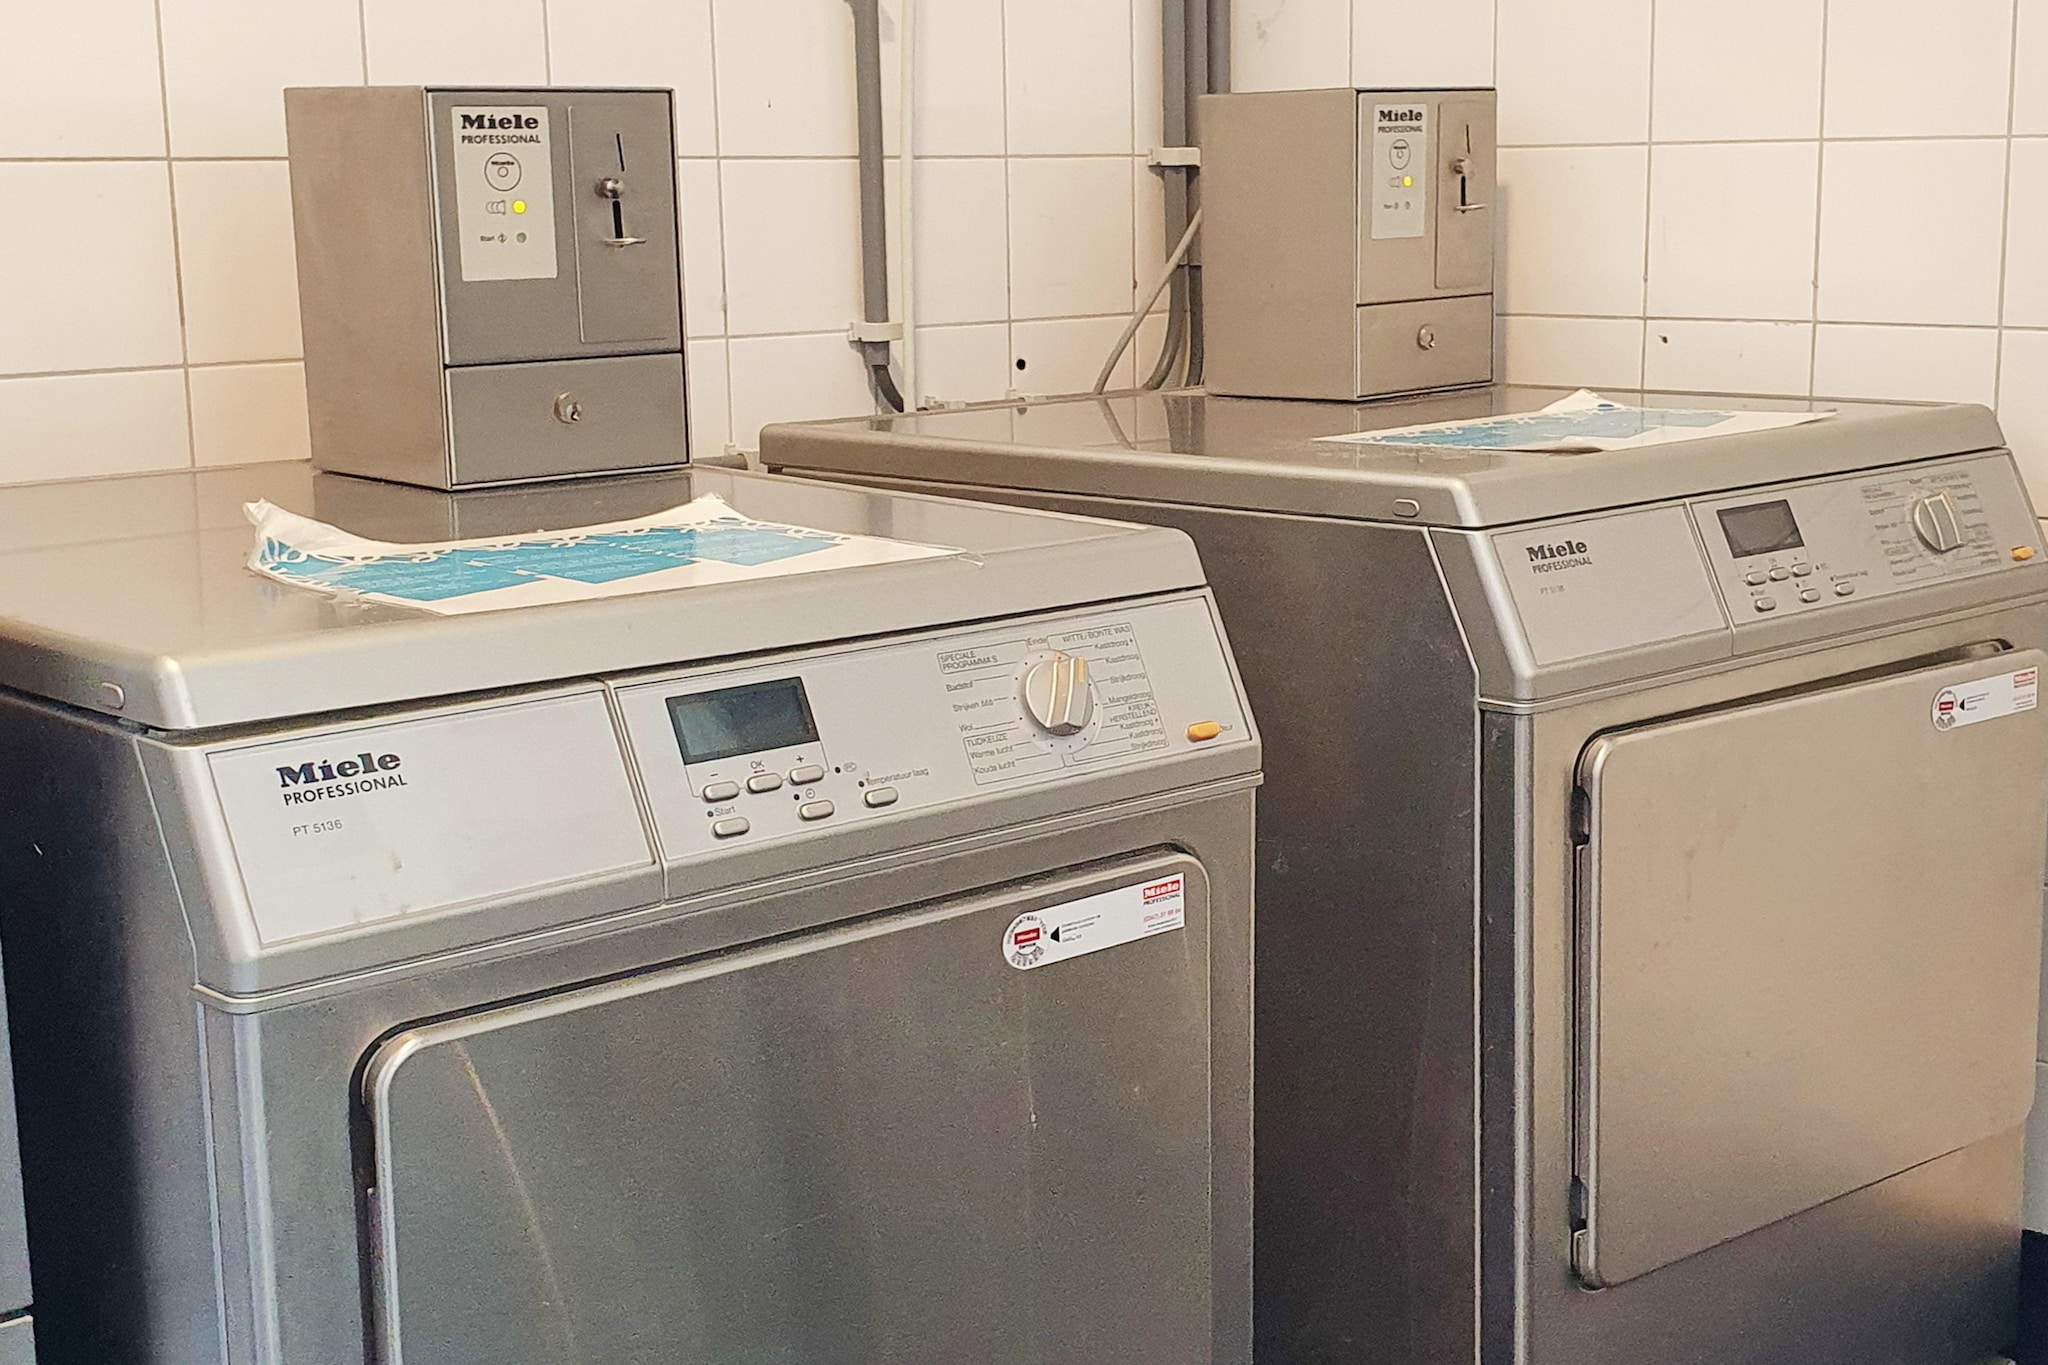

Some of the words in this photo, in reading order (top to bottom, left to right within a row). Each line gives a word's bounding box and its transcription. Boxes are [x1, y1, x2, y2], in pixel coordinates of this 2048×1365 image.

[460, 114, 539, 130] Miele
[1378, 110, 1423, 122] Miele
[461, 134, 541, 145] PROFESSIONAL
[1525, 540, 1588, 562] Miele
[1532, 556, 1593, 574] PROFESSIONAL
[940, 650, 976, 663] SPECIALE
[276, 752, 401, 788] Miele
[750, 760, 765, 770] OK
[283, 774, 408, 806] PROFESSIONAL
[714, 806, 736, 817] Start
[292, 825, 309, 837] PT
[313, 819, 343, 834] 5136
[1144, 881, 1180, 898] Miele
